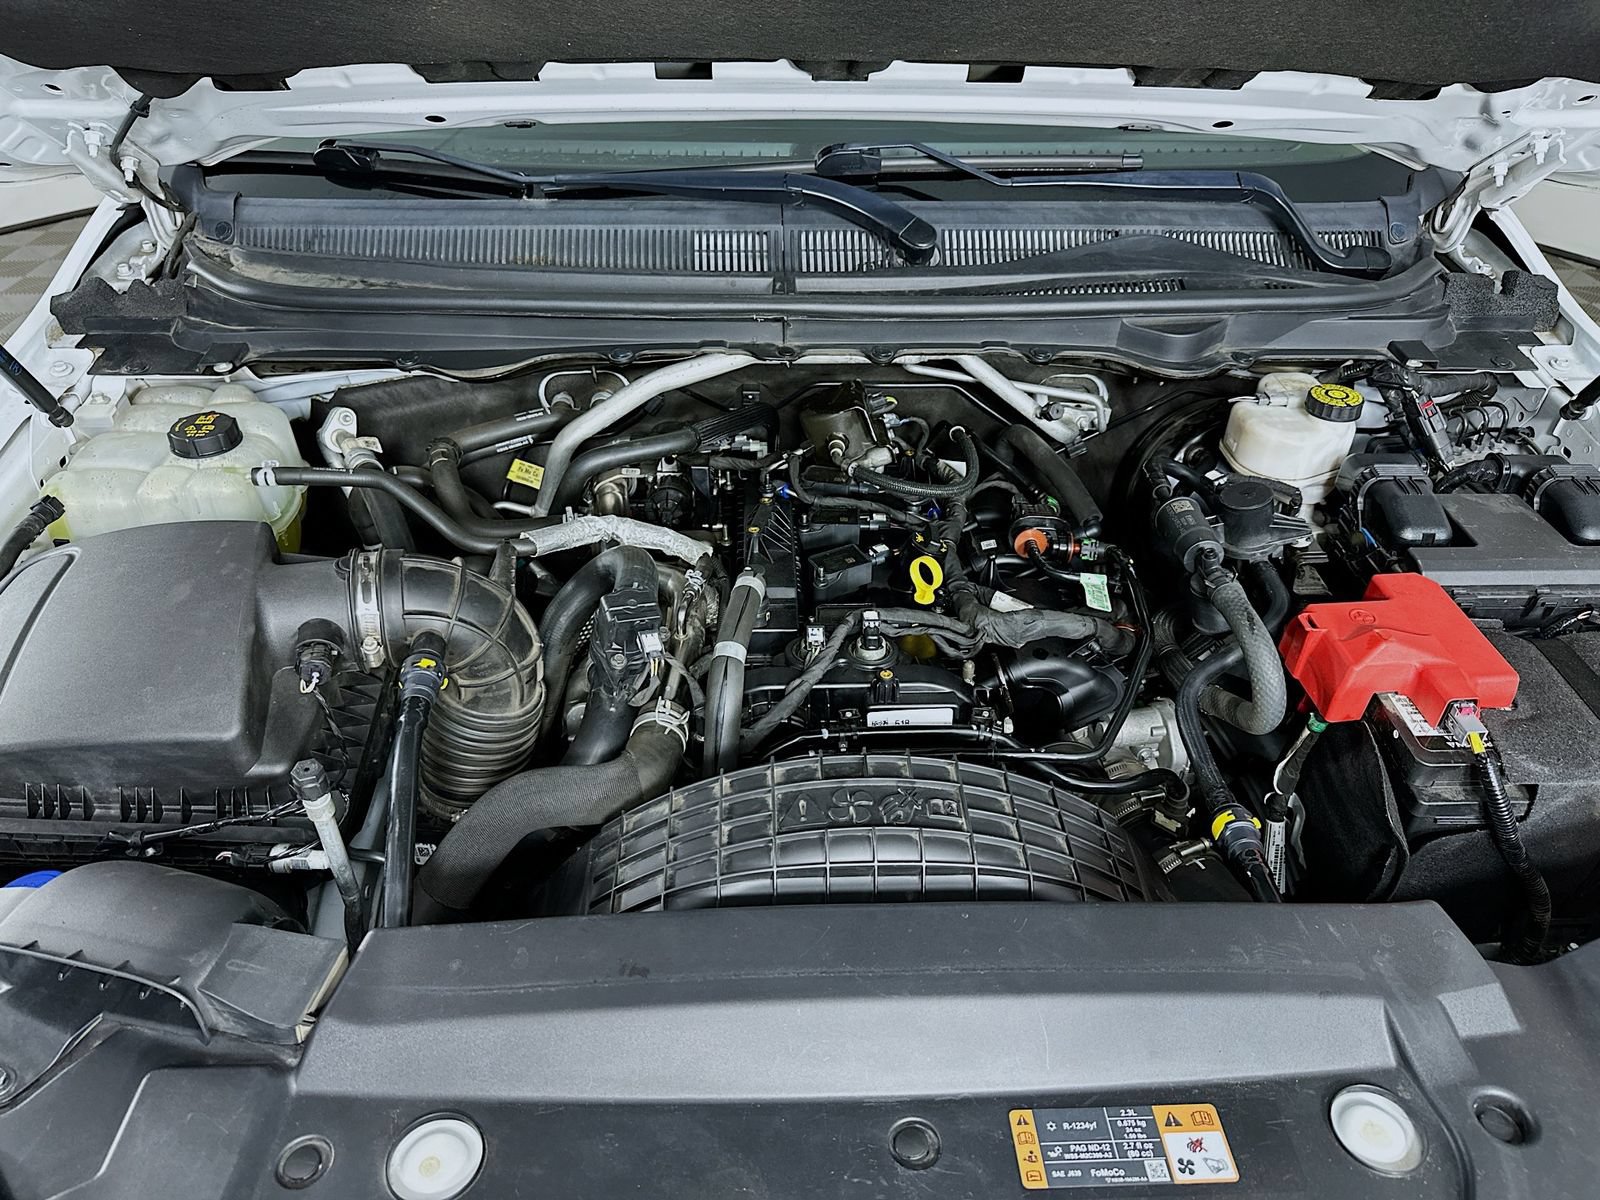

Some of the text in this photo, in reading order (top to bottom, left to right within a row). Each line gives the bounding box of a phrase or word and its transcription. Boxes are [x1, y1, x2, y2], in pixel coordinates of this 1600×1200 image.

[1062, 1121, 1097, 1130] R-1234yf
[1137, 1120, 1147, 1128] kg
[1070, 1143, 1111, 1152] PAG ND-12
[1123, 1142, 1134, 1150] 2.7
[1090, 1168, 1125, 1177] FoMoCo
